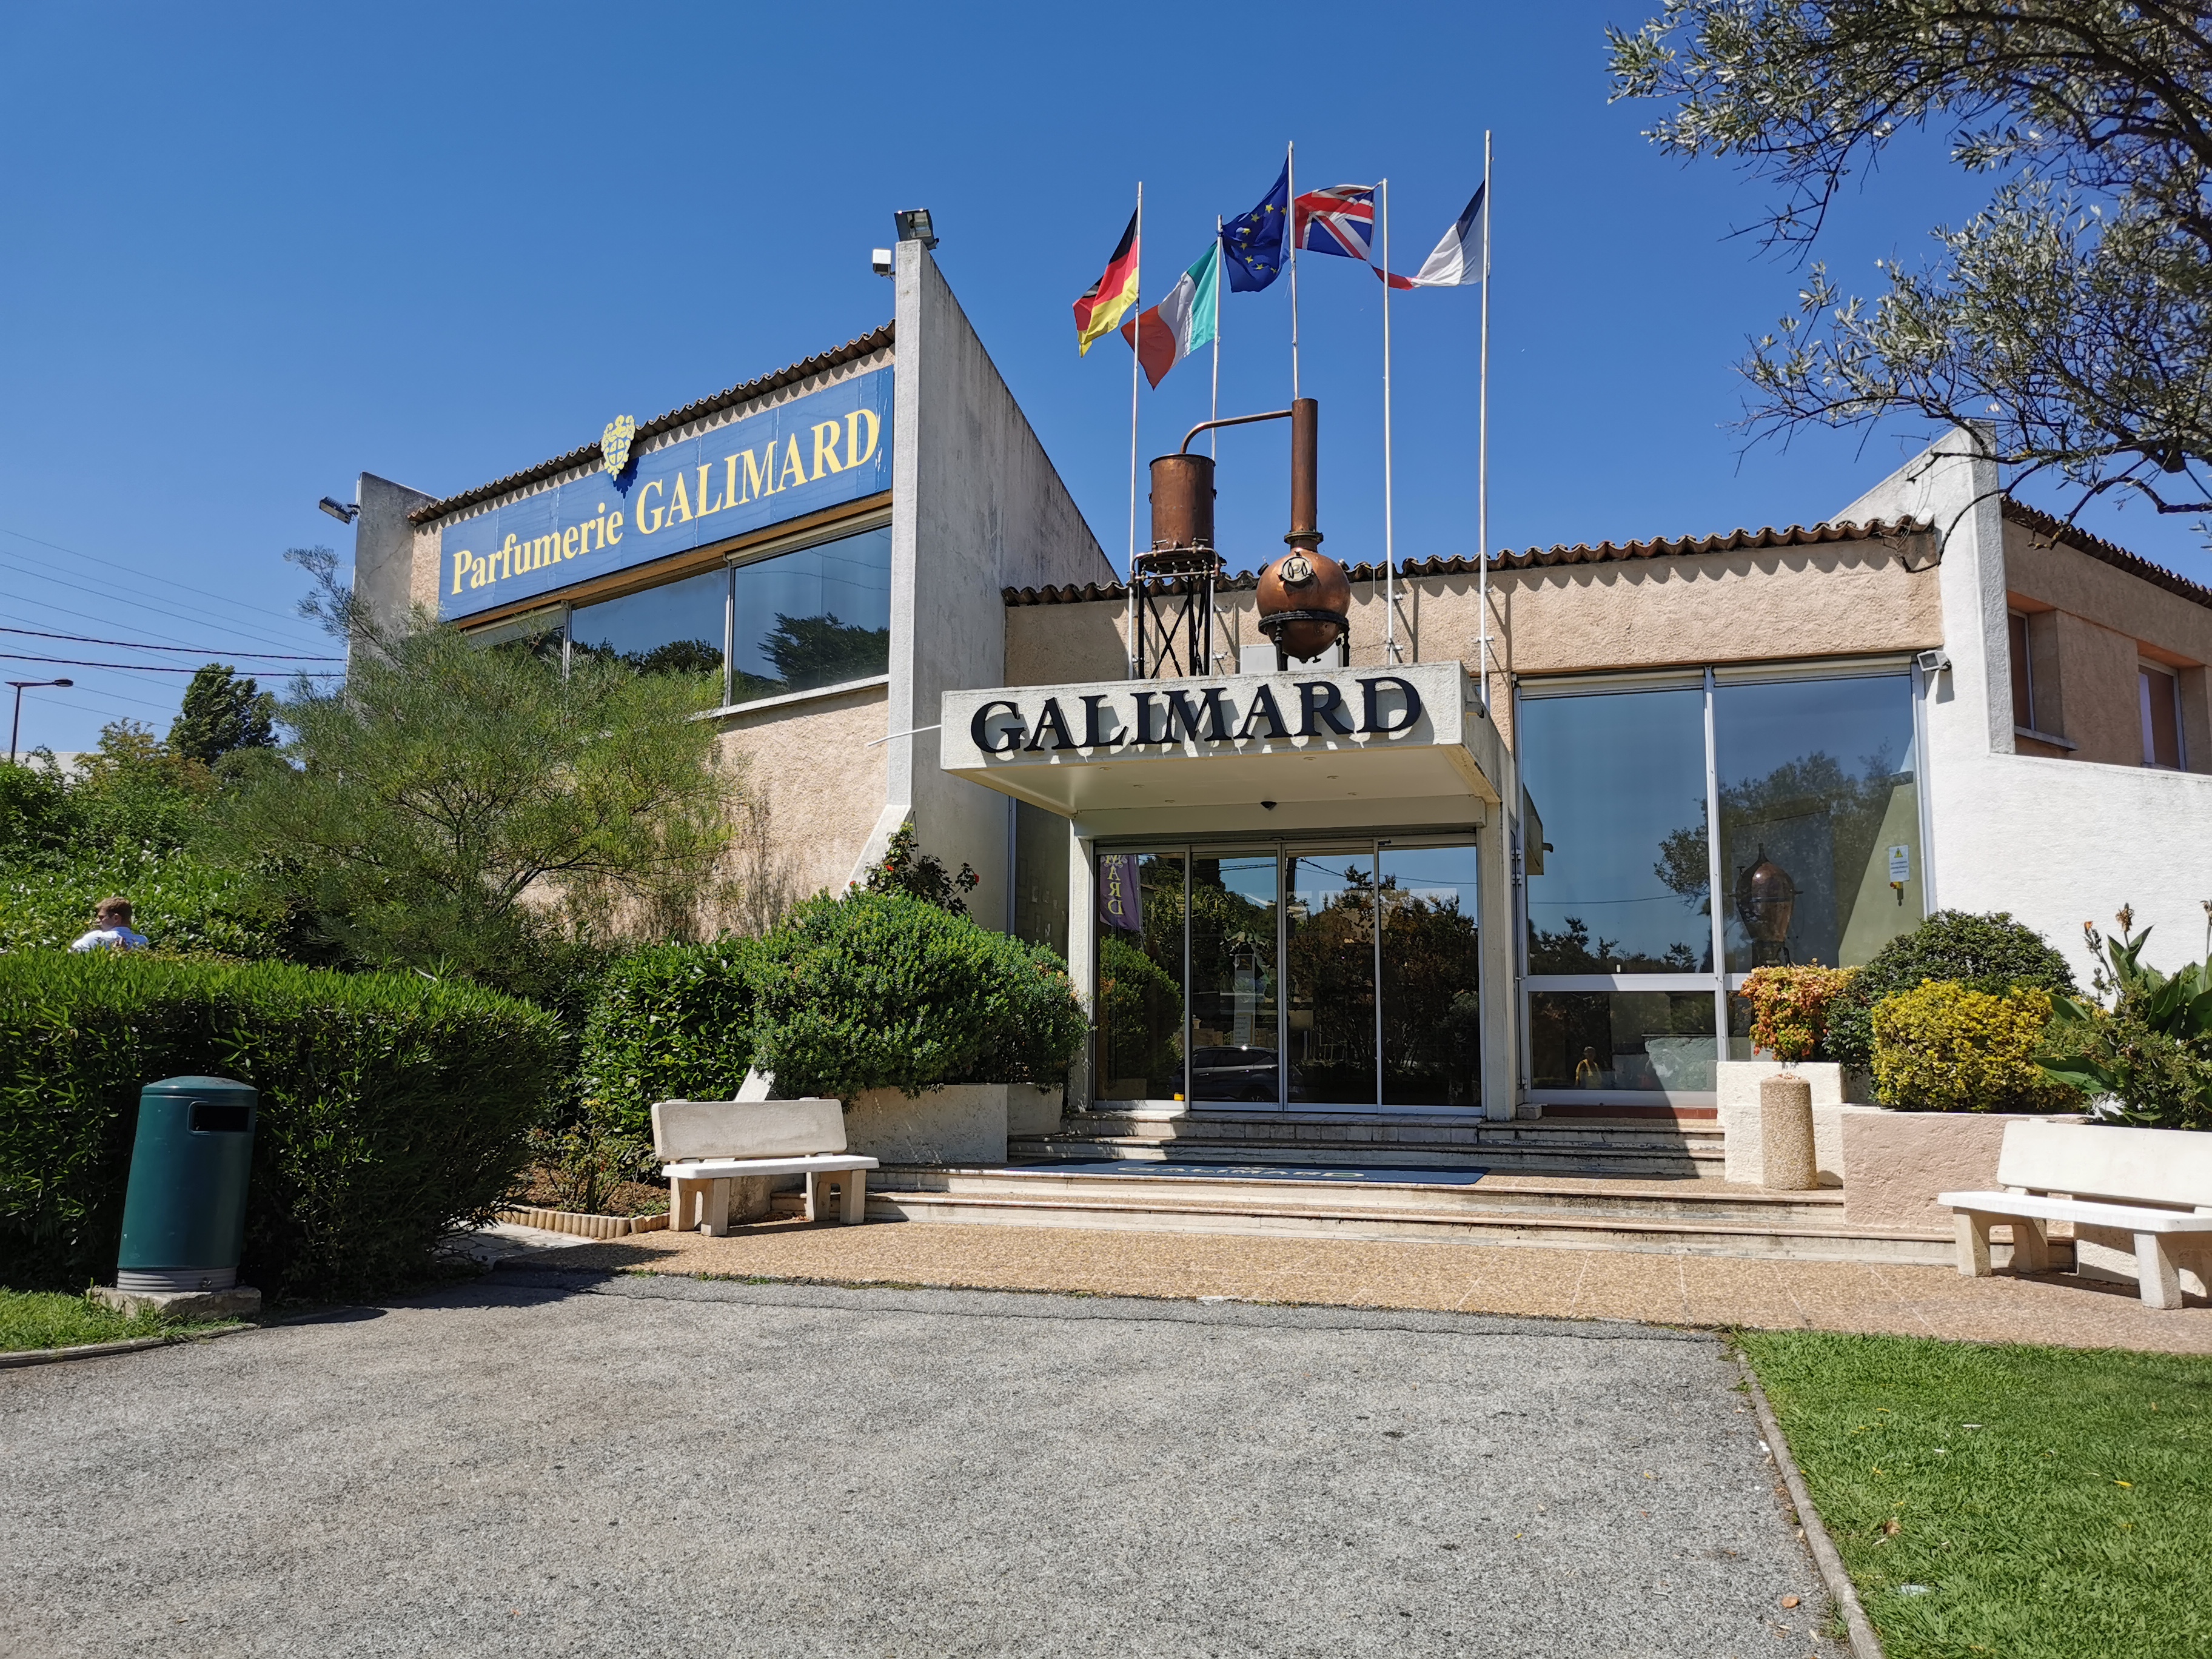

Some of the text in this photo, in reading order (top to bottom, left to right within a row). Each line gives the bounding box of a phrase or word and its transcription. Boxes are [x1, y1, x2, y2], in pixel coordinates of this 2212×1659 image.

[452, 408, 879, 595] Parfumerie GALIMARD
[970, 676, 1422, 753] GALIMARD
